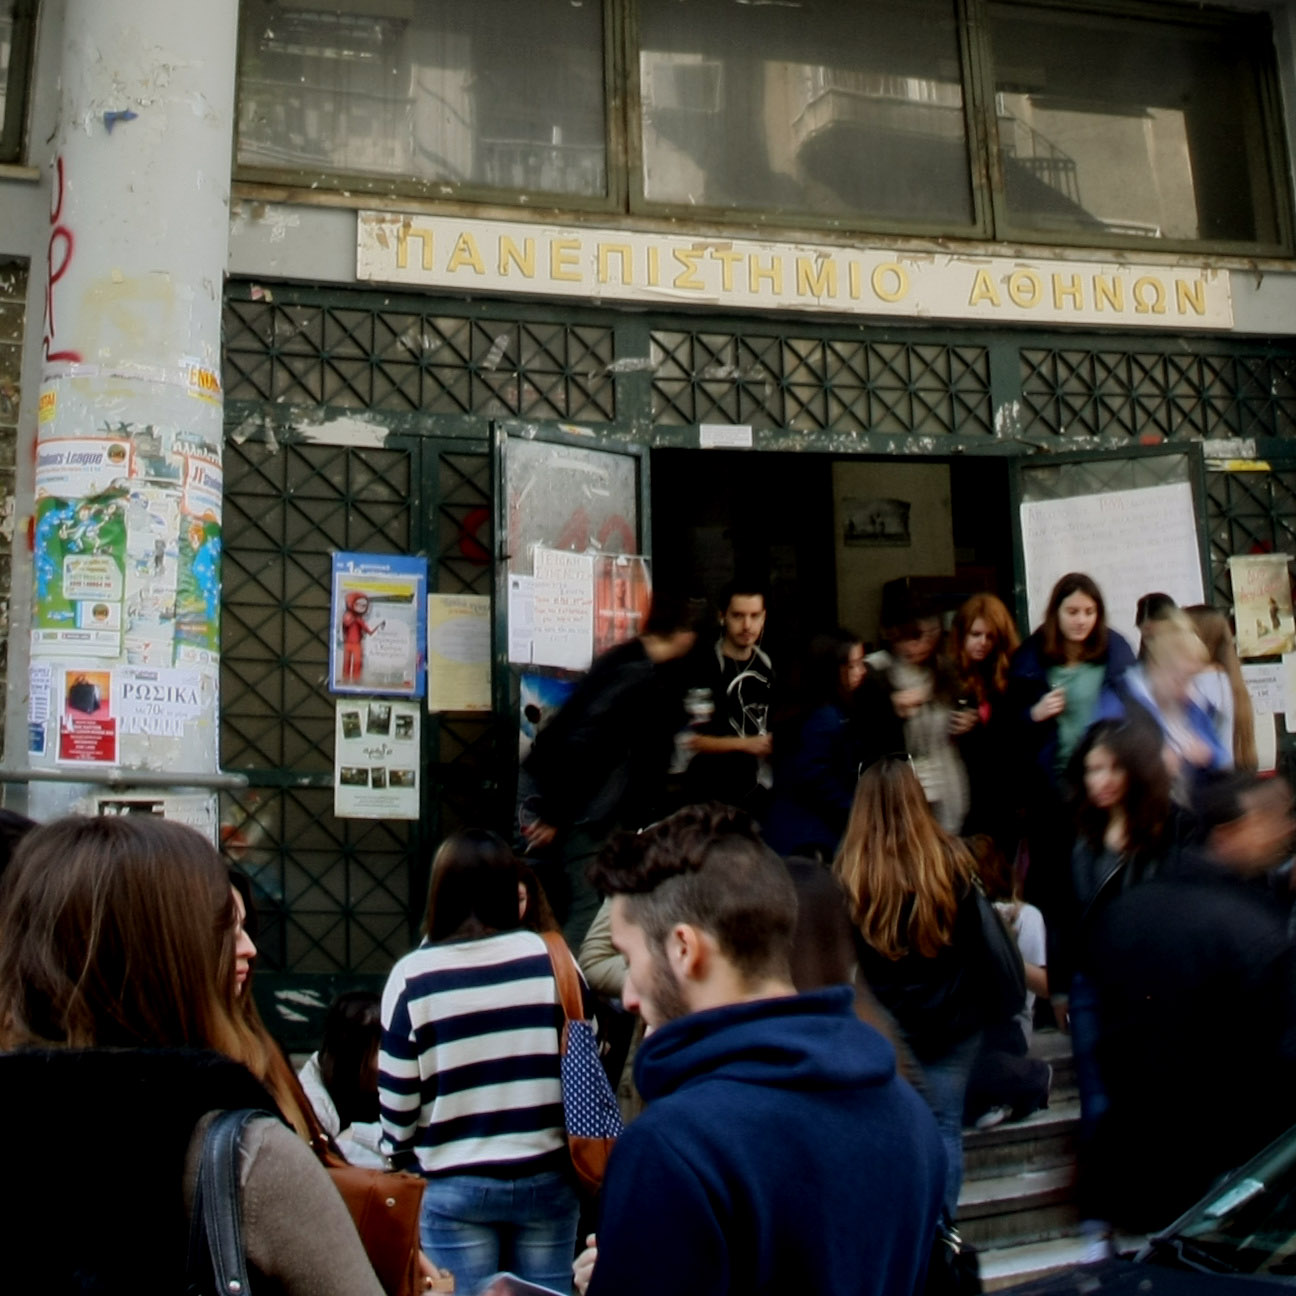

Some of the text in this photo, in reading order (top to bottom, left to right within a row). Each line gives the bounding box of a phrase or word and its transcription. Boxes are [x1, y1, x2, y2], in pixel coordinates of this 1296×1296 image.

[397, 227, 1206, 316] ΠΑΝΕΠΙΣΤΗΜΙΟ ΑΘΗΝΩΝ
[122, 683, 199, 705] ΡΩΣΙΚΑ
